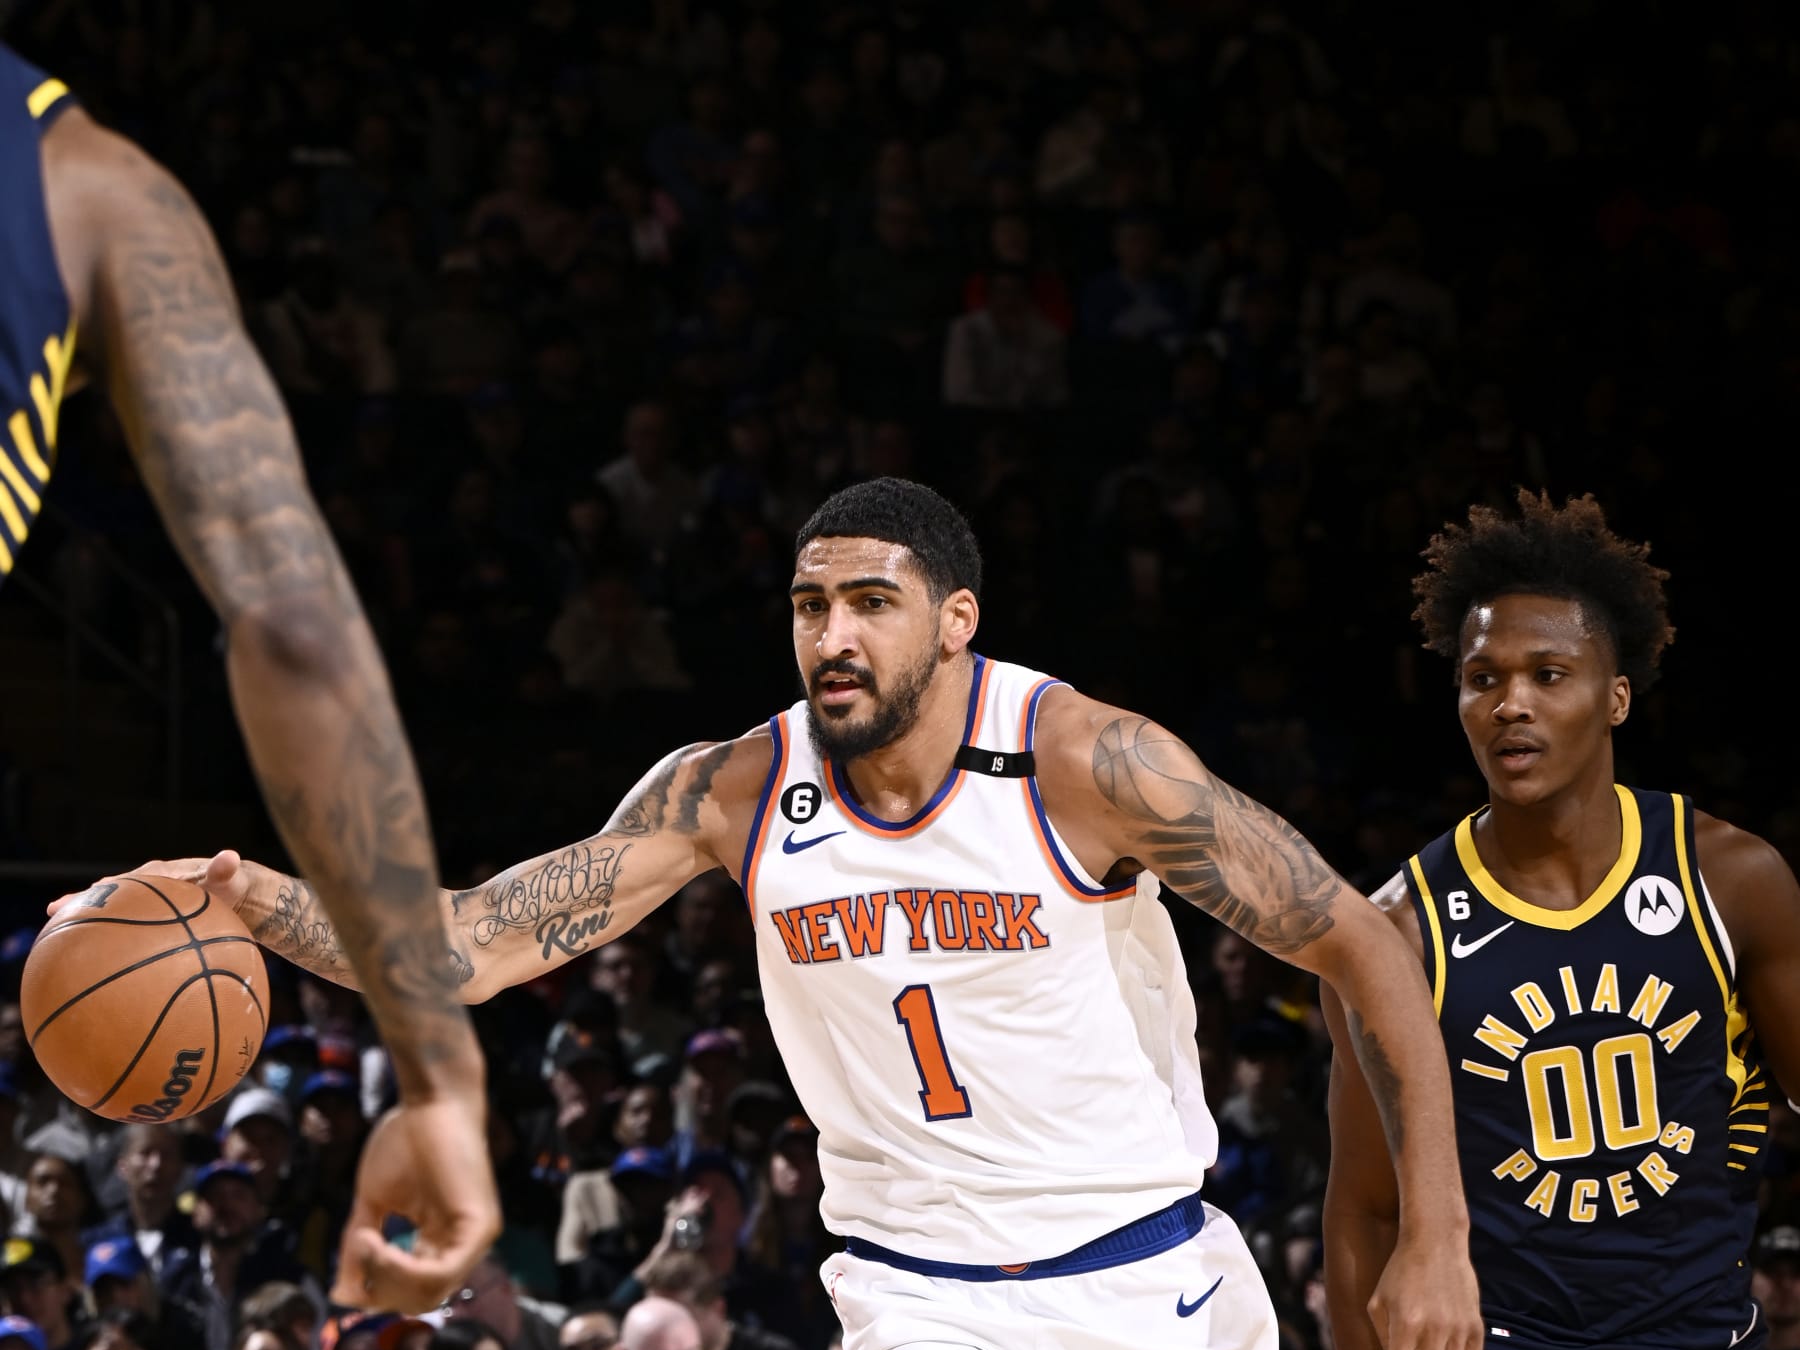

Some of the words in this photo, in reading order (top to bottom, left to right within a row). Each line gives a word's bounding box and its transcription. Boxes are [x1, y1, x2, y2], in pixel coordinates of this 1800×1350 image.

[790, 787, 813, 819] 6
[990, 755, 1005, 773] 19
[769, 890, 890, 964] NEW
[893, 887, 1052, 954] YORK
[1447, 890, 1471, 921] 6
[892, 983, 973, 1122] 1
[1461, 963, 1702, 1082] INDIANA
[1521, 1032, 1662, 1161] 00
[1491, 1121, 1696, 1223] PACERS
